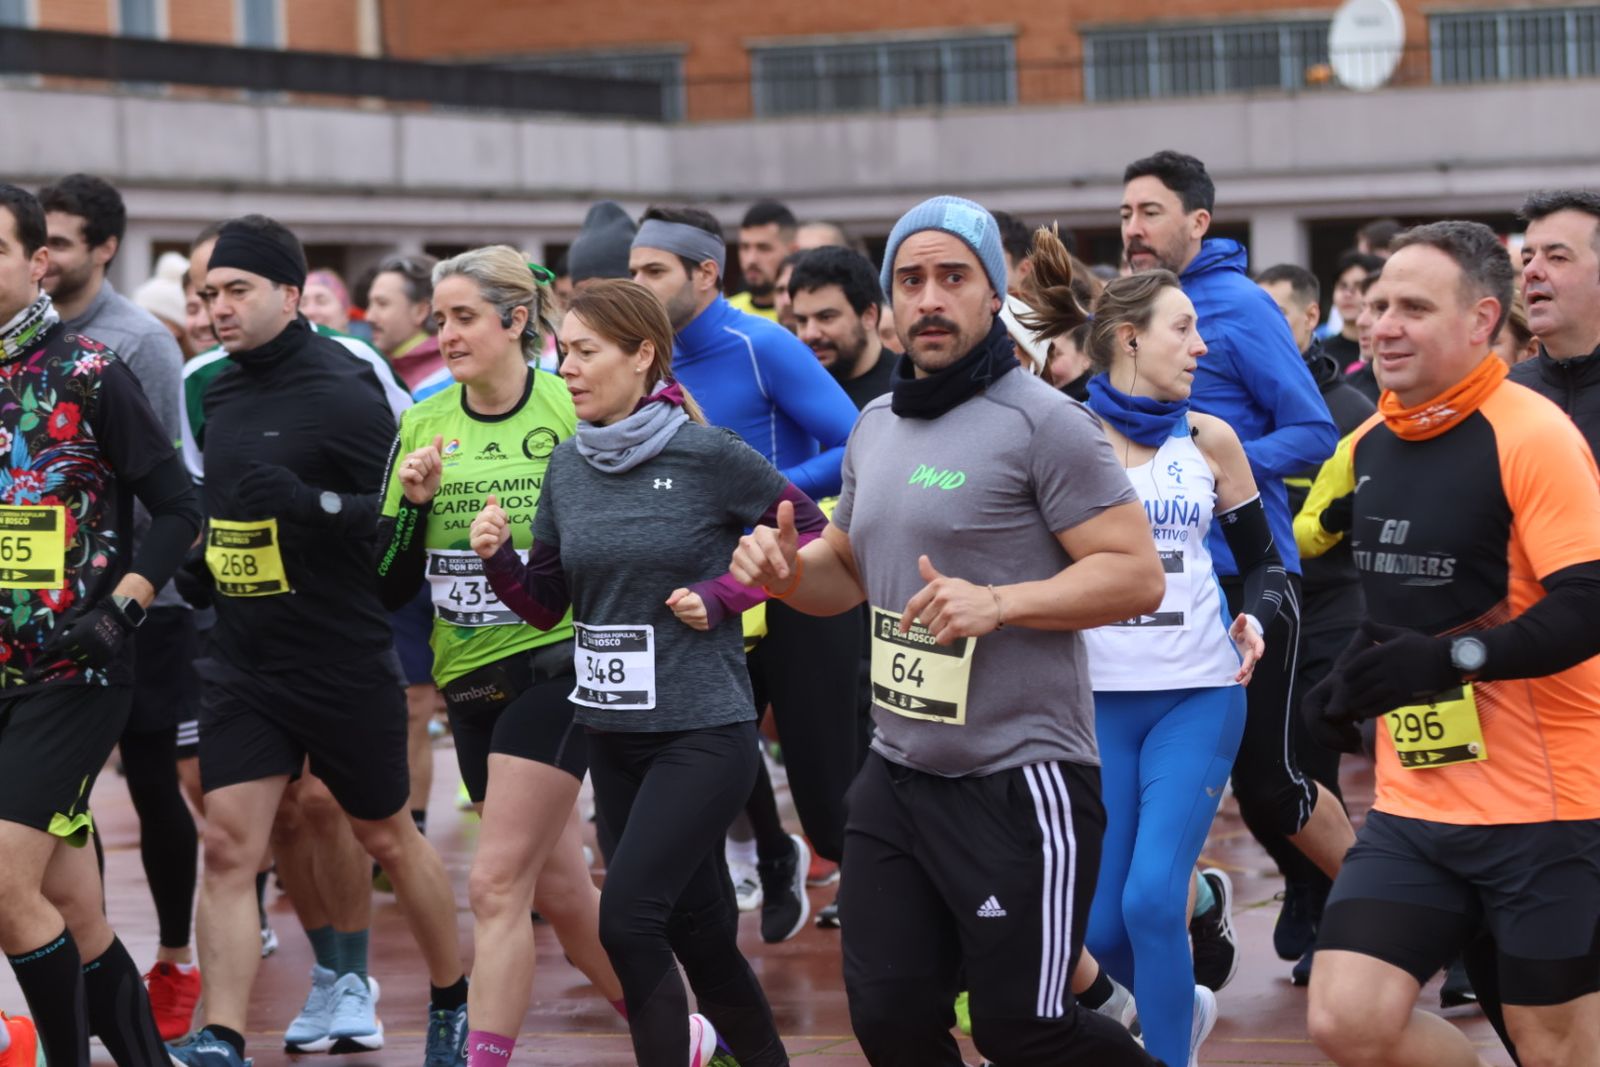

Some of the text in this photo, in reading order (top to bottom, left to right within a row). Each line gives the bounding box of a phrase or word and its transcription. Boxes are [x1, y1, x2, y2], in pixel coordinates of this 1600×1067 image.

[433, 477, 541, 497] ORRECAMIN
[907, 462, 967, 490] DAVID
[4, 517, 31, 526] BOSCO
[1379, 519, 1411, 545] GO
[0, 536, 32, 562] 65
[221, 553, 259, 577] 268
[448, 563, 484, 571] DON BOS
[1374, 552, 1457, 577] RUNNERS
[448, 581, 499, 606] 435
[908, 631, 936, 645] BOSCO
[586, 655, 626, 684] 348
[892, 652, 924, 688] 64
[1391, 711, 1445, 743] 296
